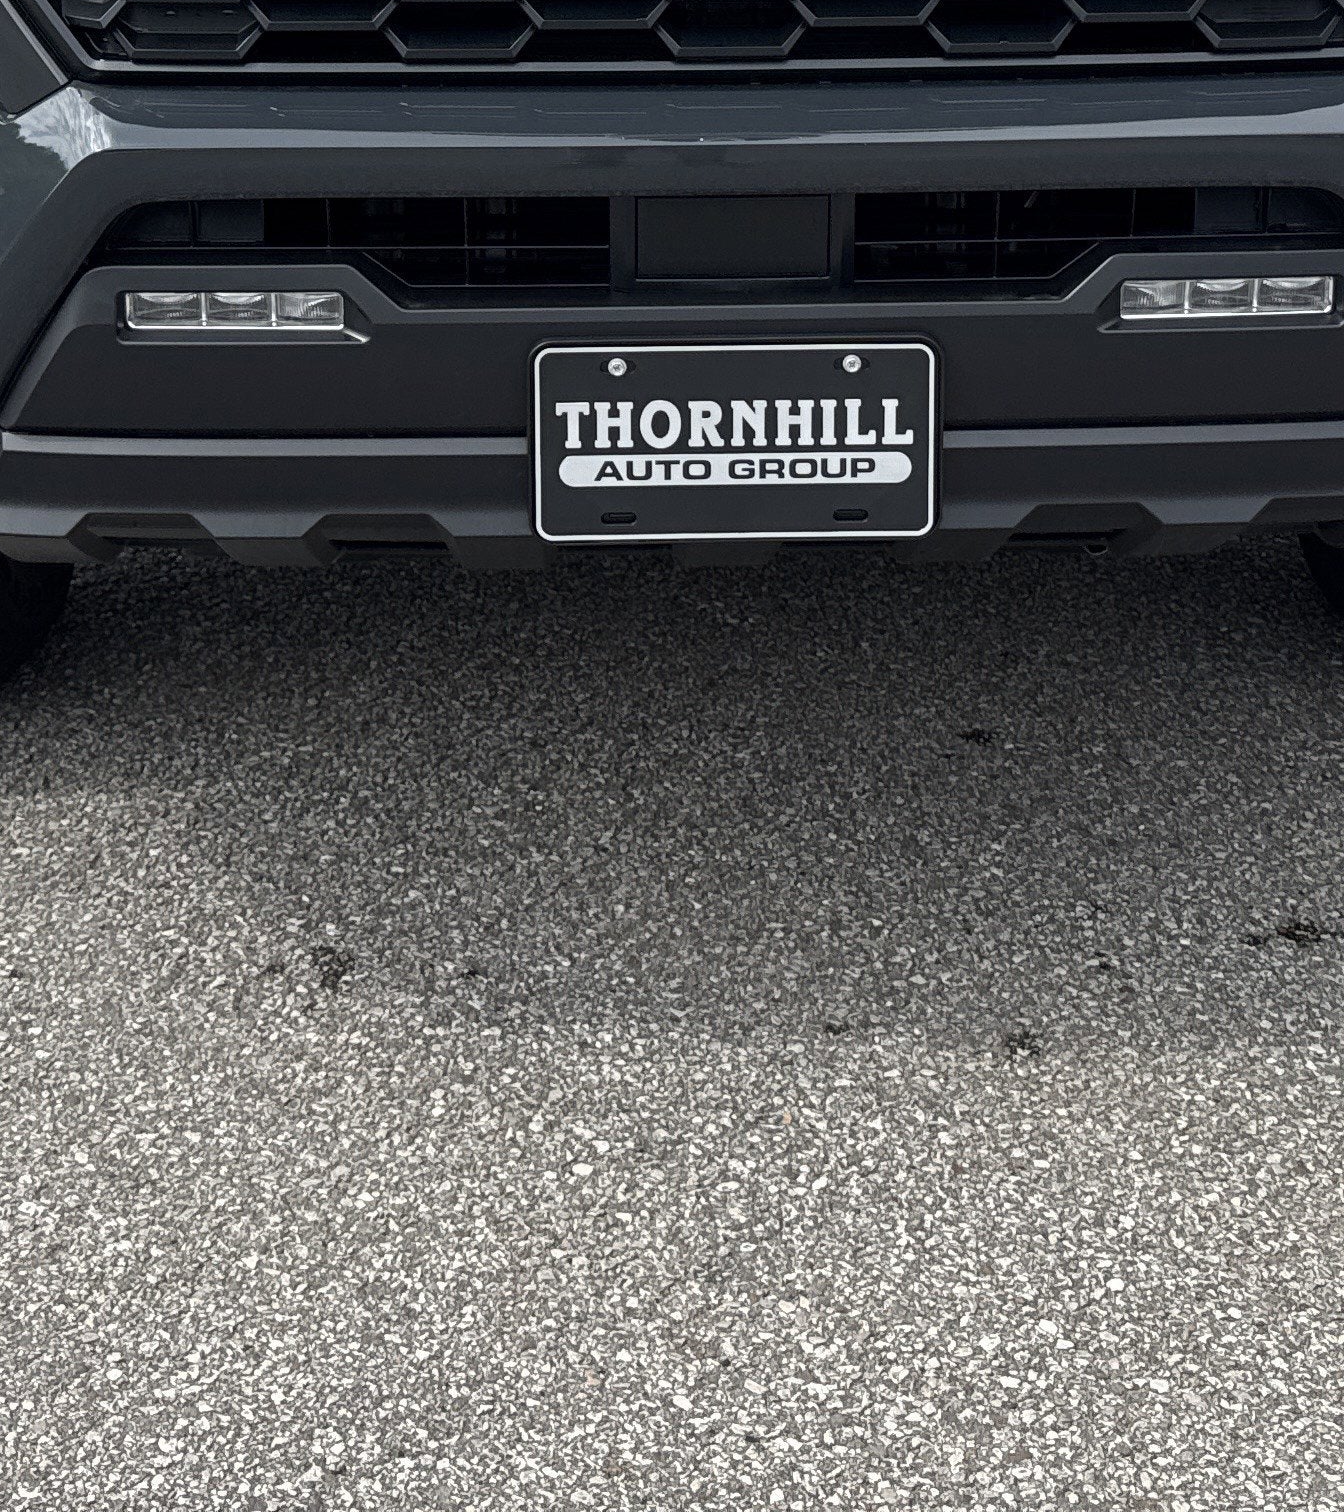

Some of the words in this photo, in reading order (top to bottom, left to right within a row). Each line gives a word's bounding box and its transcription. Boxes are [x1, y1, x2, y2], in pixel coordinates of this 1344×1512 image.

[555, 398, 914, 449] THORNHILL
[593, 459, 712, 482] AUTO
[727, 457, 876, 480] GROUP
